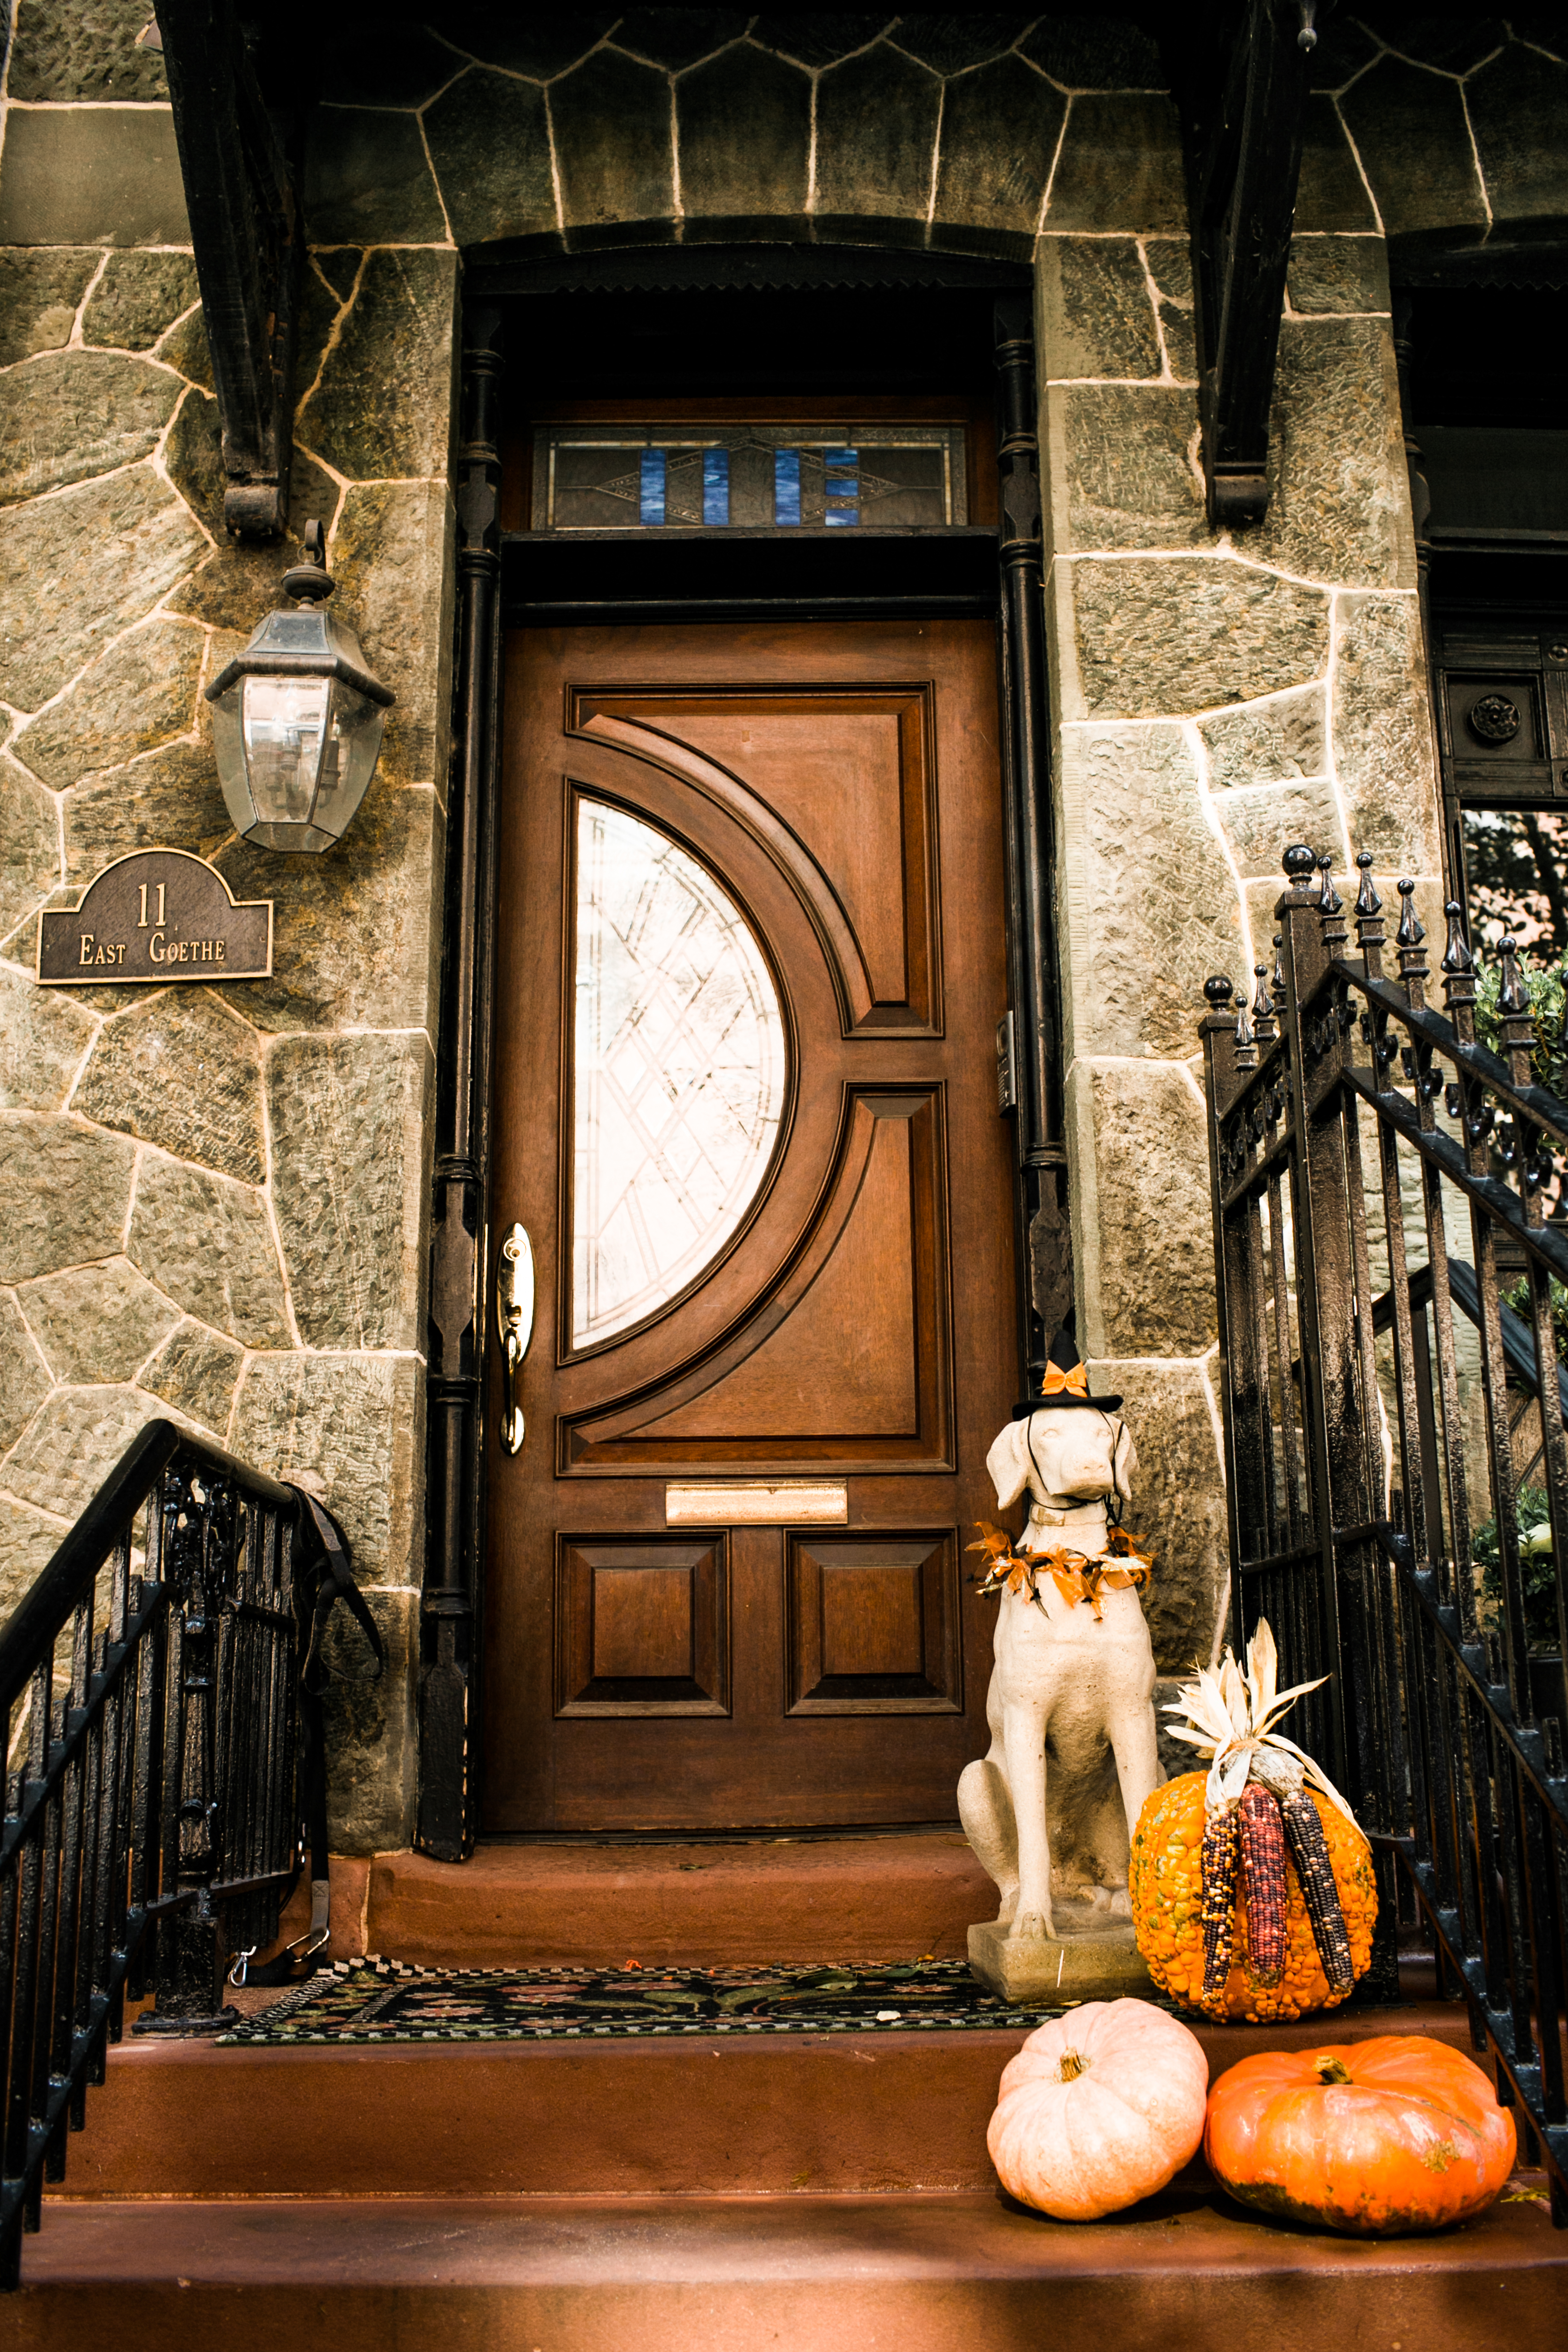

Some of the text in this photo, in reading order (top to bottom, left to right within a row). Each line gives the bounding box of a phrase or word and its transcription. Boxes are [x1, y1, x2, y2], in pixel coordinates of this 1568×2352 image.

[138, 883, 166, 927] 11
[79, 932, 225, 965] EAST GOETHE
